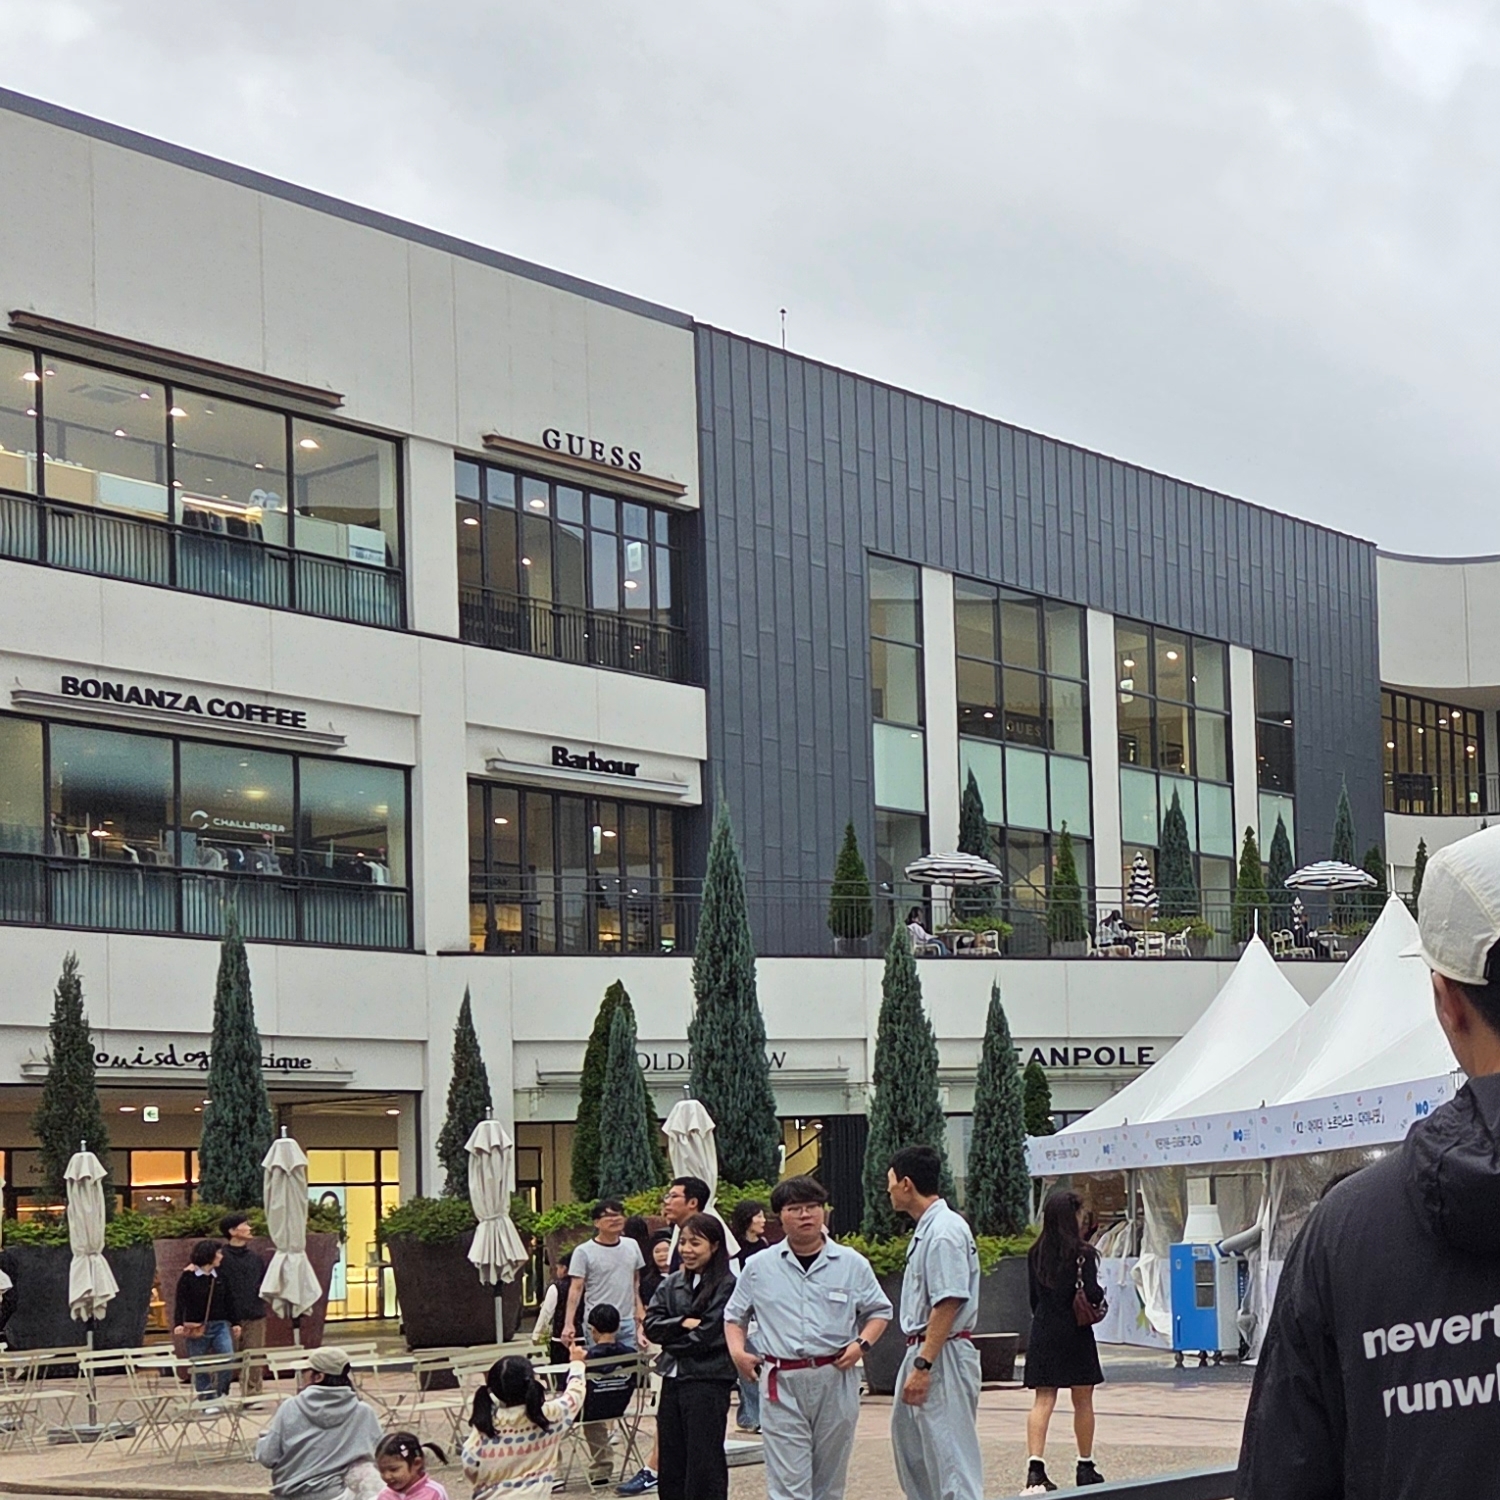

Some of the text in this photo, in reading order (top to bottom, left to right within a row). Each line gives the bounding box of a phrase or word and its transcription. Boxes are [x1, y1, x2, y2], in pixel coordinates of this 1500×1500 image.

[542, 428, 642, 472] GUESS
[61, 676, 307, 729] BONANZA COFFEE
[1005, 720, 1041, 737] GUES
[551, 745, 640, 777] Barbour
[212, 817, 285, 833] CHALLENGER
[95, 1043, 211, 1071] ouisdog
